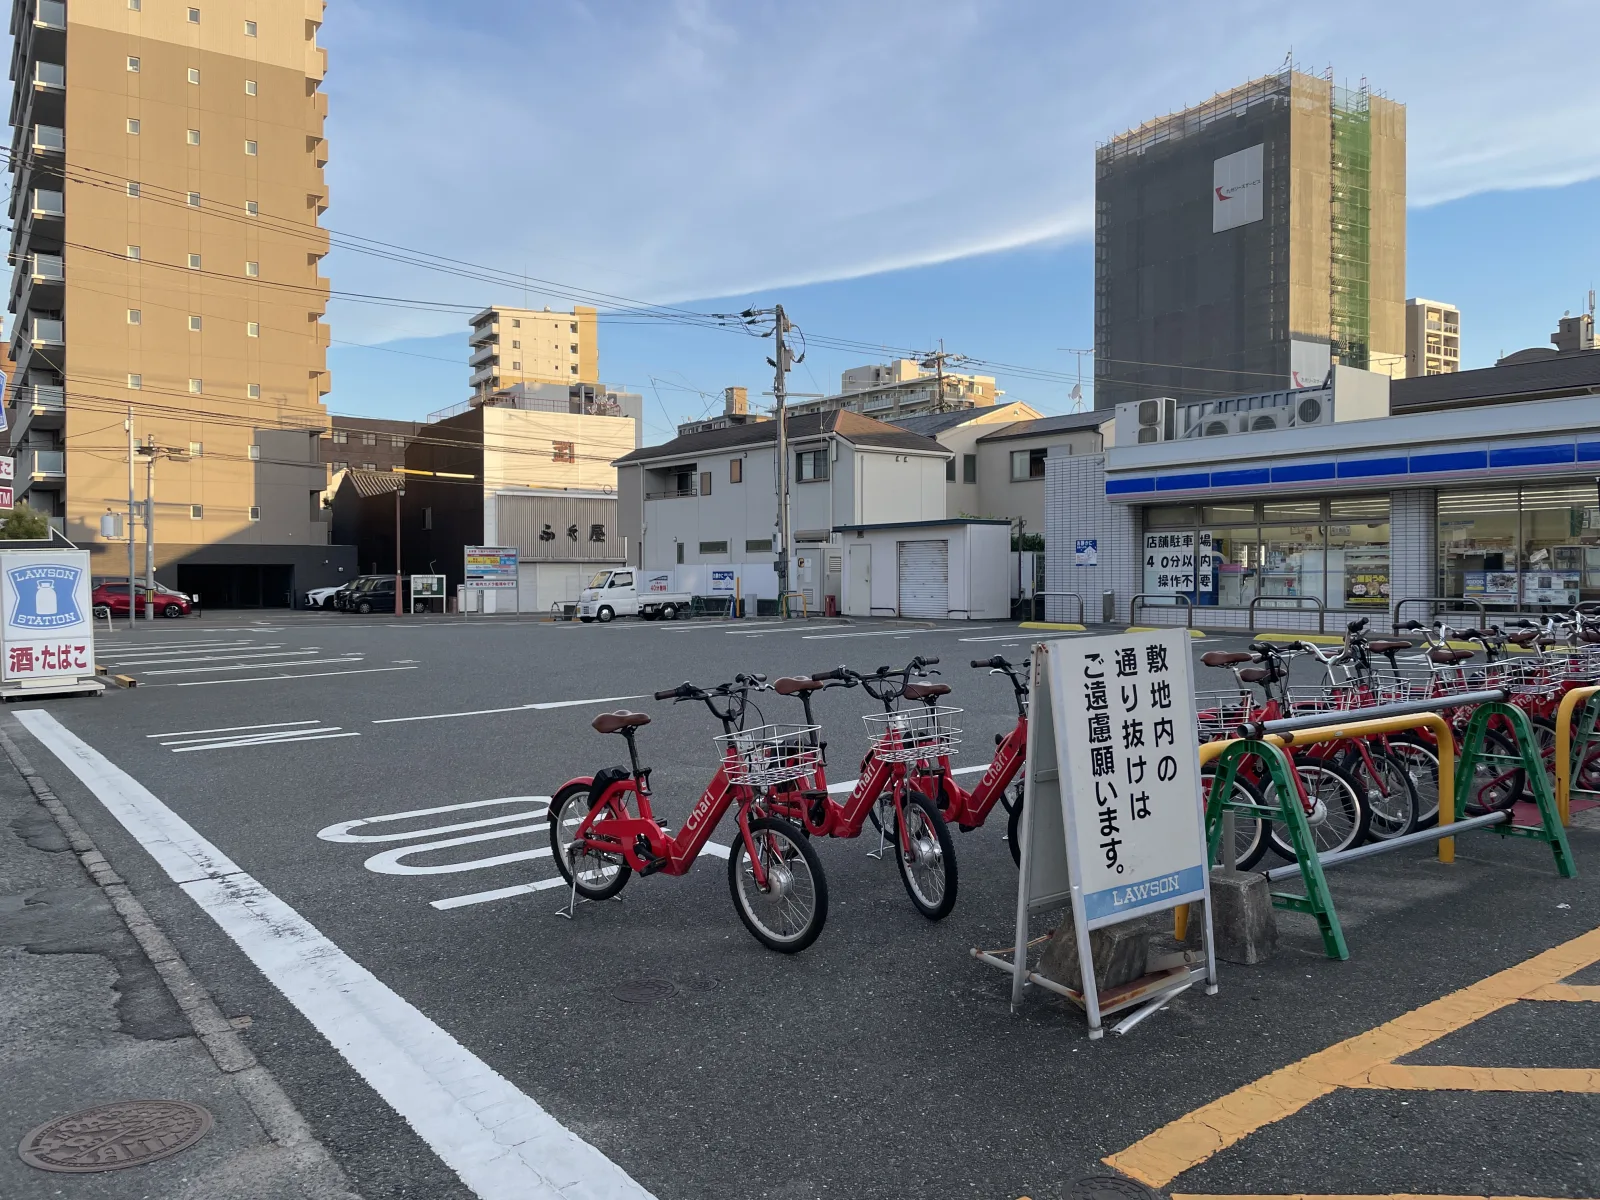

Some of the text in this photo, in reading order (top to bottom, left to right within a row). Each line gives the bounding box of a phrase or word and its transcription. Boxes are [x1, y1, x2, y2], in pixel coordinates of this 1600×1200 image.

[539, 524, 605, 543] ふく屋
[1146, 533, 1212, 549] 店舗駐車場
[14, 568, 76, 582] LAWSON
[1157, 574, 1212, 588] 操作不要
[17, 612, 76, 625] STATION
[9, 644, 87, 673] 酒・たばこ
[1146, 644, 1178, 782] 敷地内の
[1115, 648, 1151, 821] 通り抜けは
[982, 752, 1009, 787] Chari
[1084, 653, 1124, 875] ご遠慮願います。
[852, 763, 876, 800] Chari
[686, 790, 715, 831] Chari
[1112, 874, 1180, 907] LAWSON
